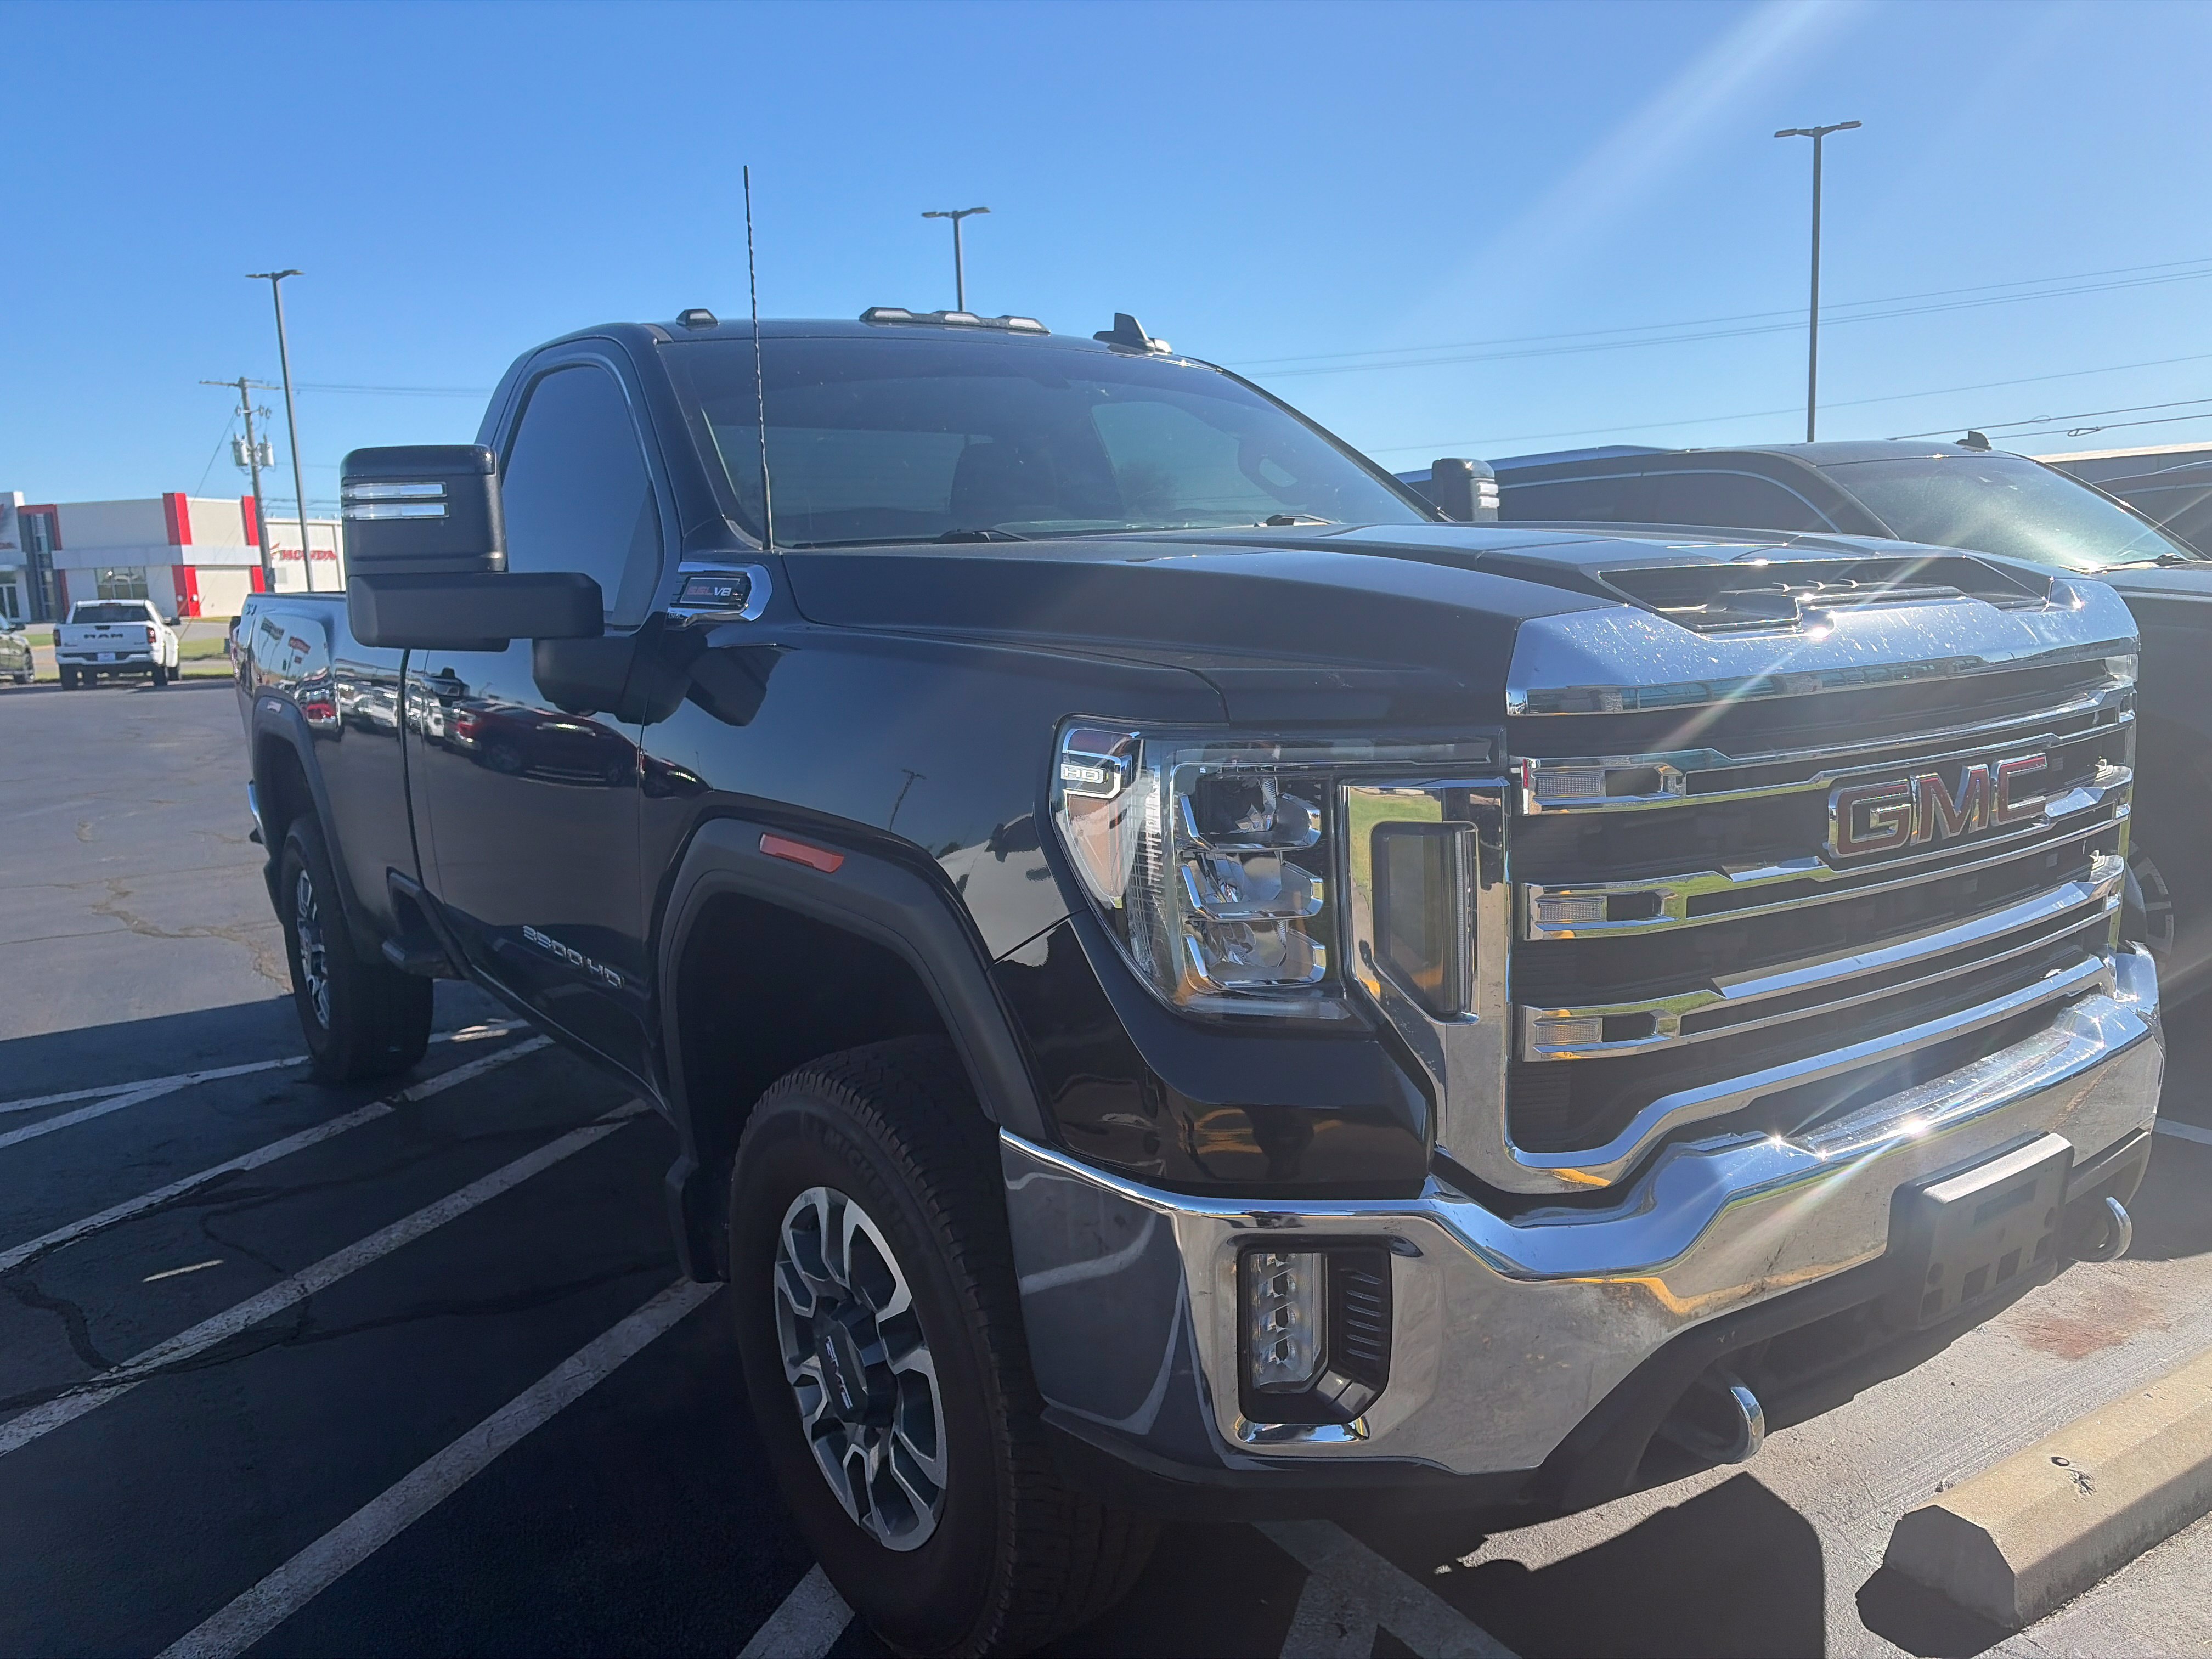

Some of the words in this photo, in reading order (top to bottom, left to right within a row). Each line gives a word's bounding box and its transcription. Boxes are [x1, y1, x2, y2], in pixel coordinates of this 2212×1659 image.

[714, 587, 732, 596] V8
[1064, 767, 1099, 780] HD
[1828, 753, 2047, 858] GMC
